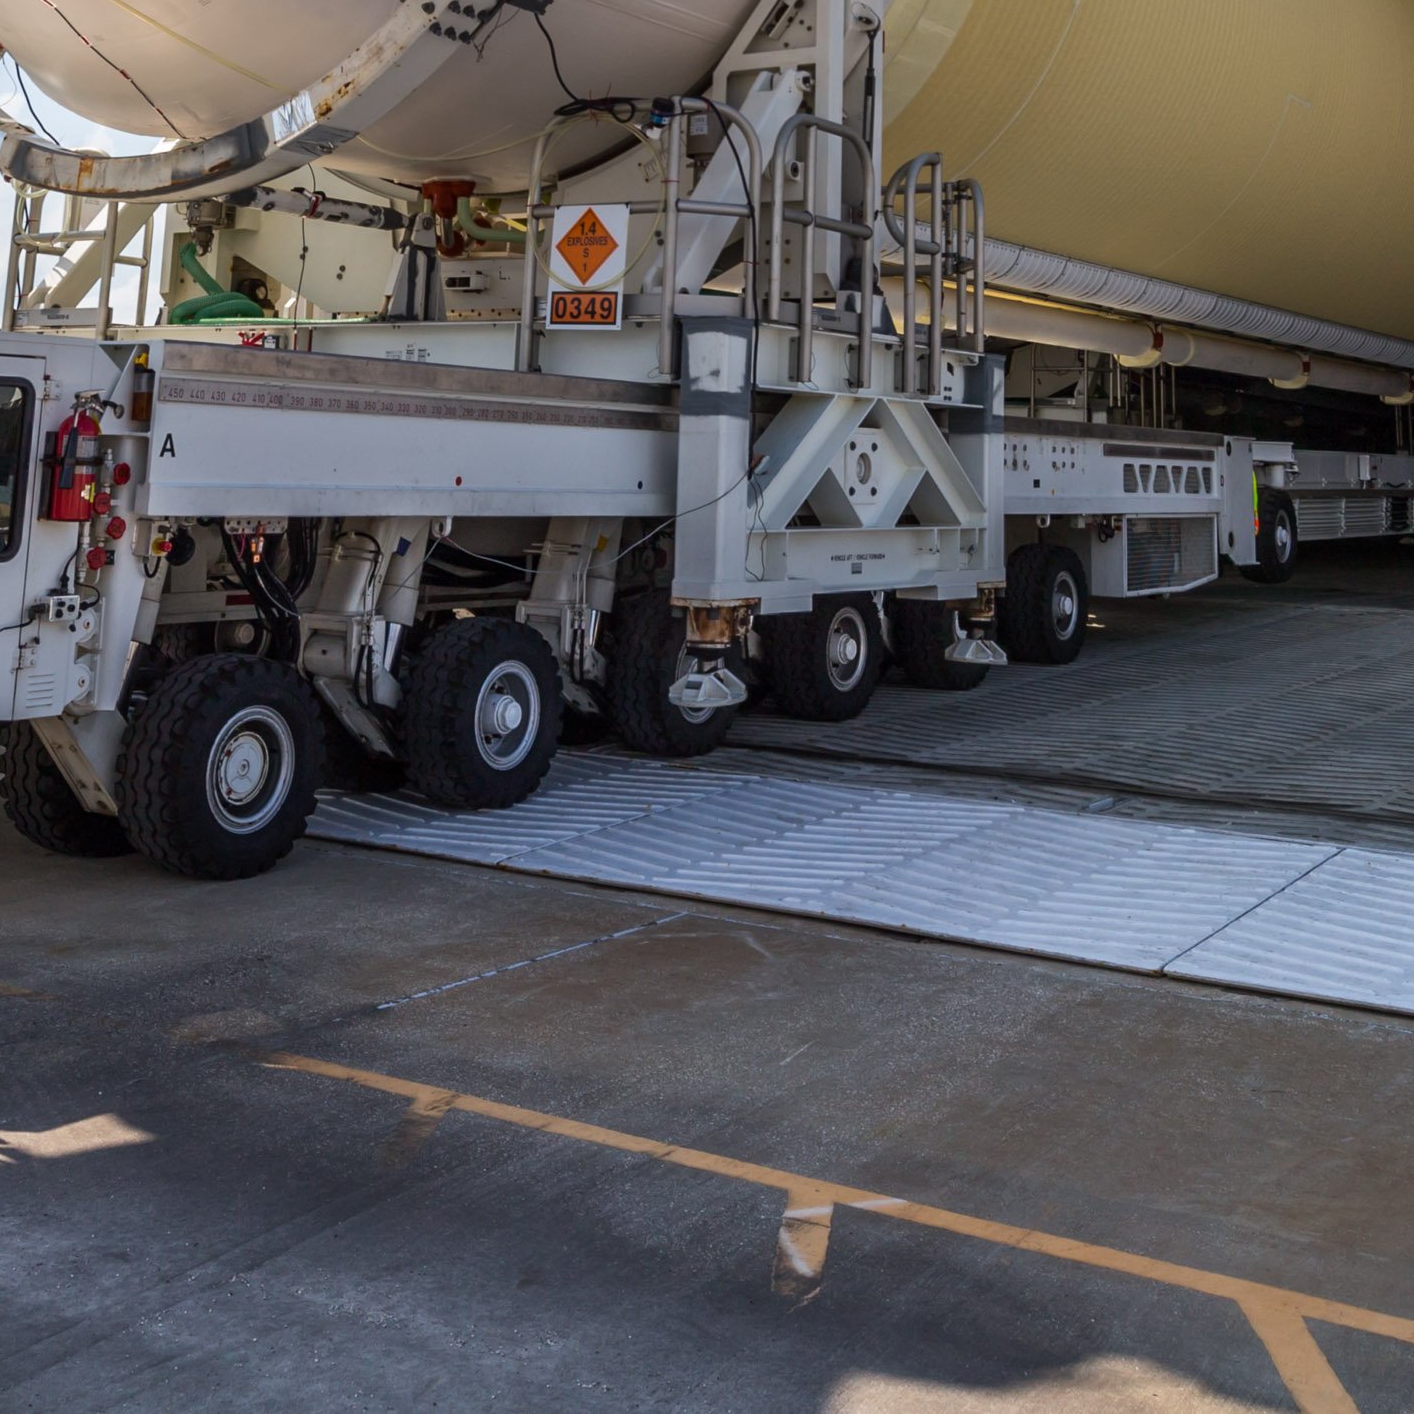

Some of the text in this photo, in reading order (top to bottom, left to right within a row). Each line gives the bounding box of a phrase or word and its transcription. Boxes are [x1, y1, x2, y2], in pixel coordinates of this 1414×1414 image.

[579, 221, 596, 236] 1.4
[567, 237, 608, 247] EXPLOSIVES
[582, 248, 590, 258] S
[554, 296, 613, 320] 0349
[168, 387, 184, 399] 450
[190, 389, 205, 400] 440
[211, 391, 226, 401] 430
[231, 392, 246, 402] 420
[252, 393, 265, 404] 410
[269, 394, 283, 405] 400
[290, 396, 304, 406] 390
[309, 397, 323, 408] 380
[328, 398, 341, 408] 370
[363, 400, 377, 411] 350
[381, 401, 393, 411] 340
[159, 433, 176, 458] A
